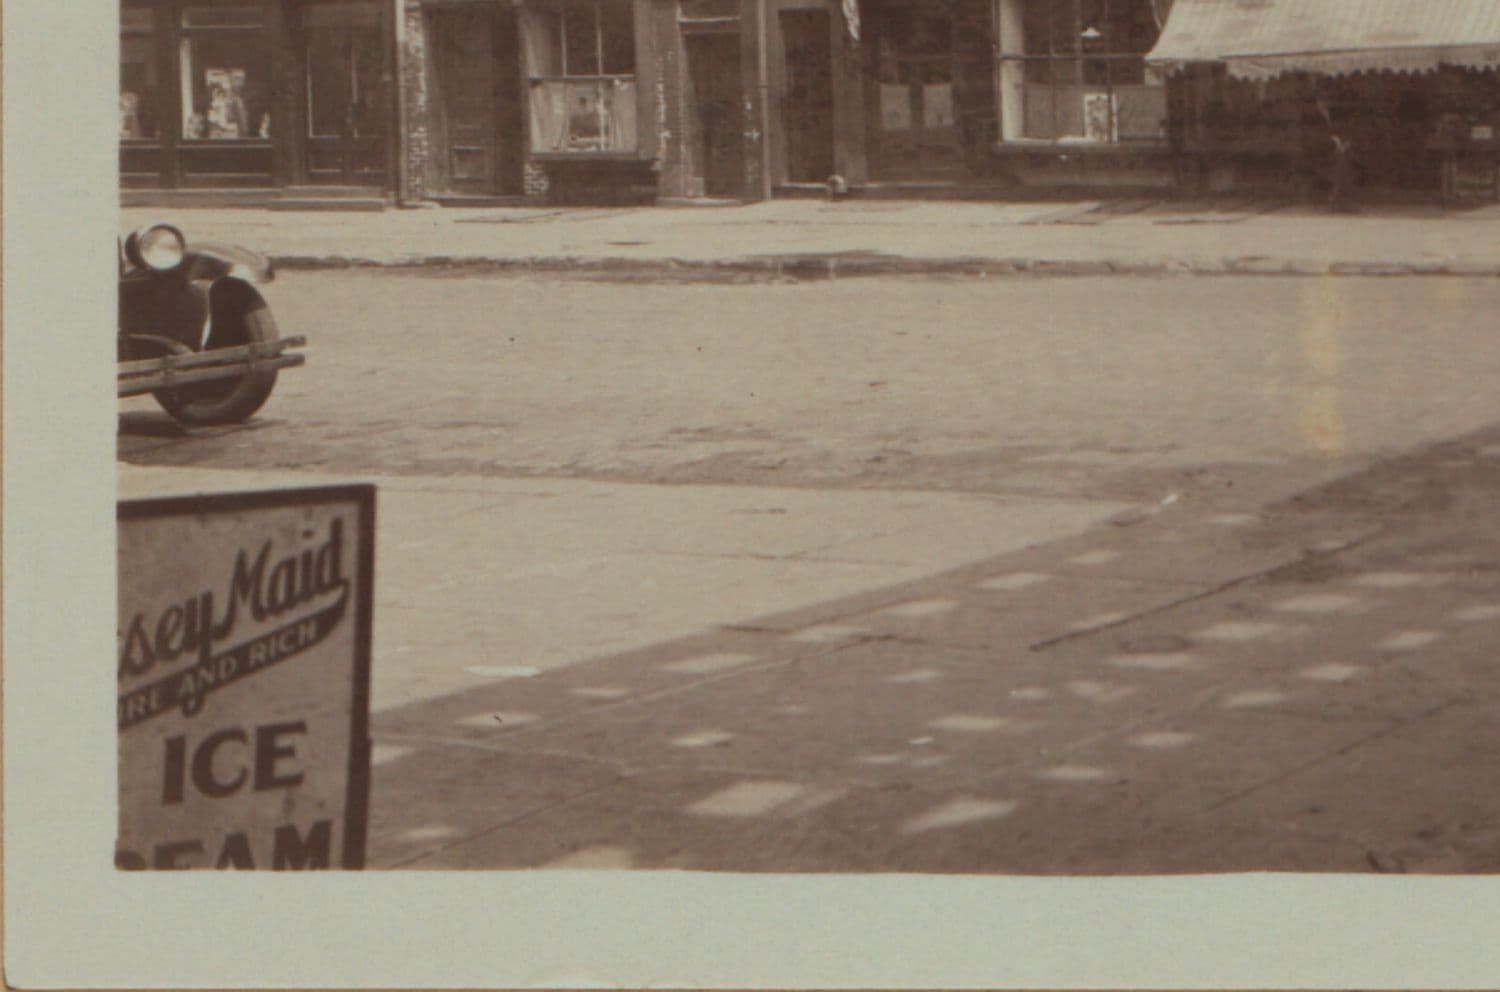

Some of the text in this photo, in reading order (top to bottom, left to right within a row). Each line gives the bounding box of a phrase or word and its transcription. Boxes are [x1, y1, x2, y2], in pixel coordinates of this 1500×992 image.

[211, 517, 347, 640] Maid
[119, 621, 318, 720] RE AND RICH
[162, 721, 307, 805] ICE
[114, 819, 333, 871] EAM
